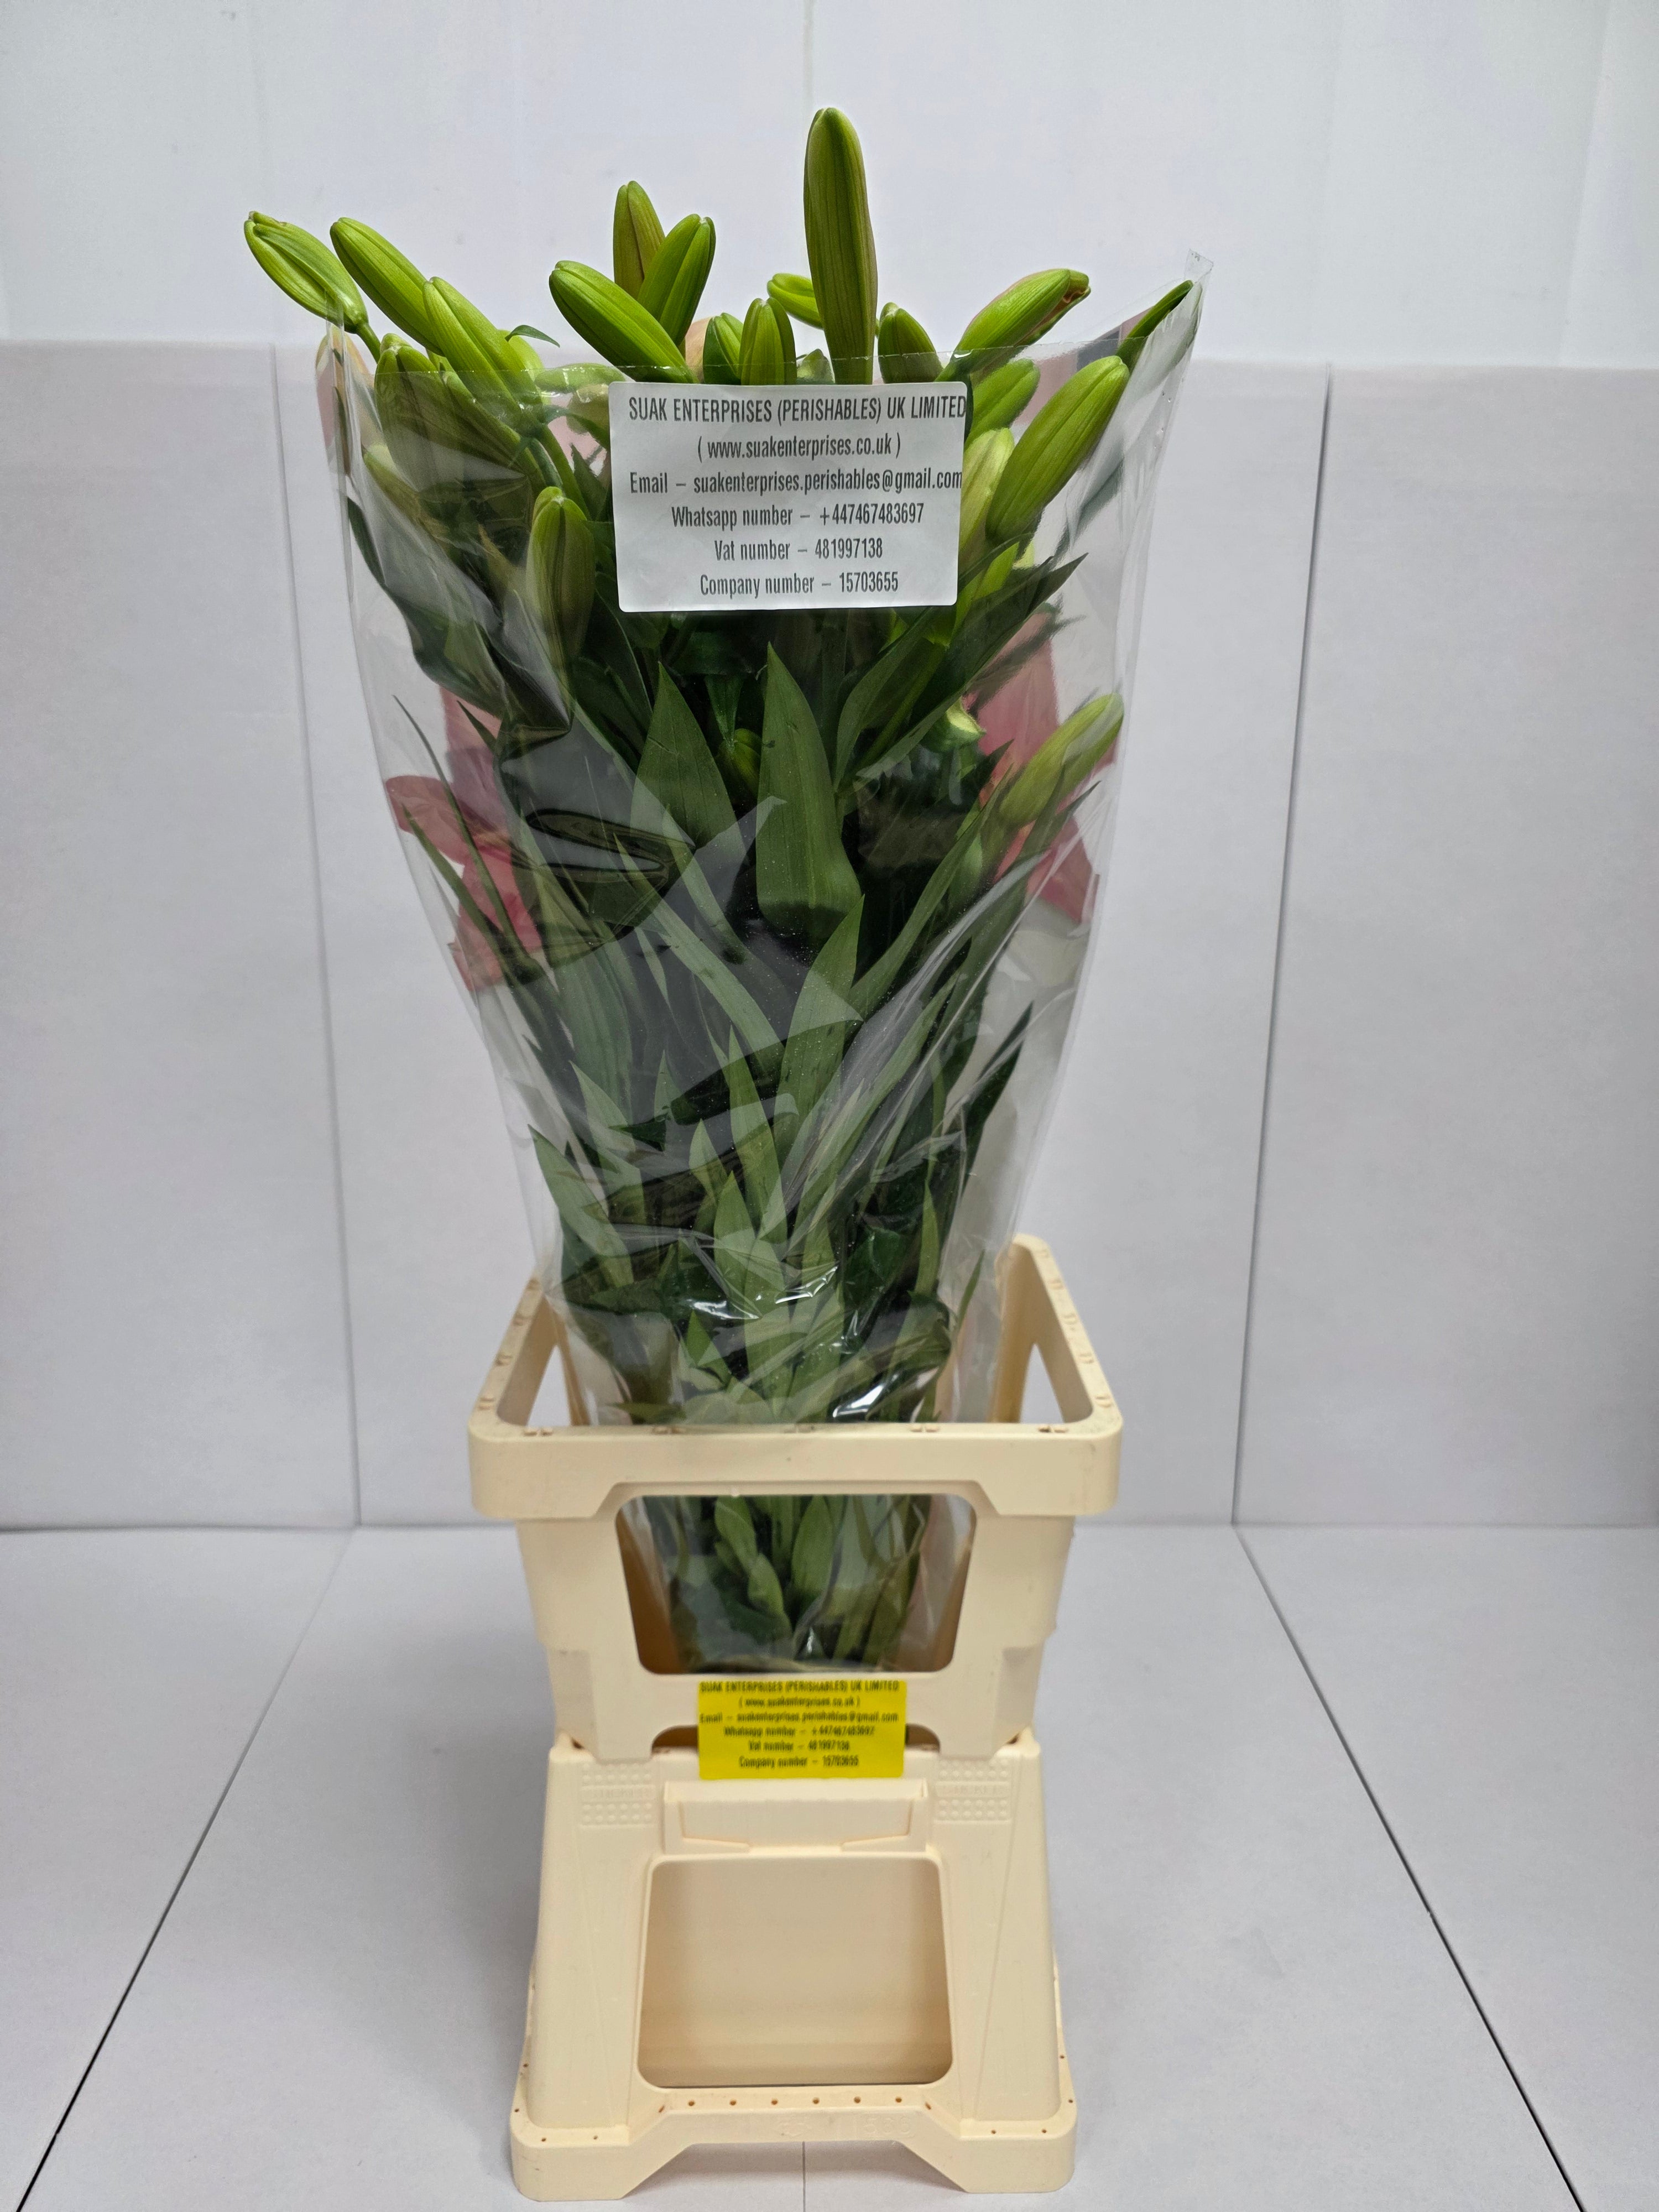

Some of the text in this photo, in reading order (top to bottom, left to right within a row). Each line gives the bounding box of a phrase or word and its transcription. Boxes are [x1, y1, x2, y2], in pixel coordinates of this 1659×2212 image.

[629, 395, 966, 427] SUAK ENTERPRISES (PERISHABLES) UK LIMITED
[707, 432, 892, 461] www.suakenterprises.co.uk
[630, 472, 668, 494] Email
[671, 506, 737, 531] Whatsapp
[743, 505, 793, 526] number
[820, 502, 924, 526] +447467483697
[714, 540, 735, 561] Vat
[740, 539, 790, 561] number
[815, 538, 883, 559] 481997138
[700, 574, 760, 599] Company
[765, 573, 815, 594] number
[839, 571, 899, 593] 15703655
[850, 1681, 862, 1692] UK
